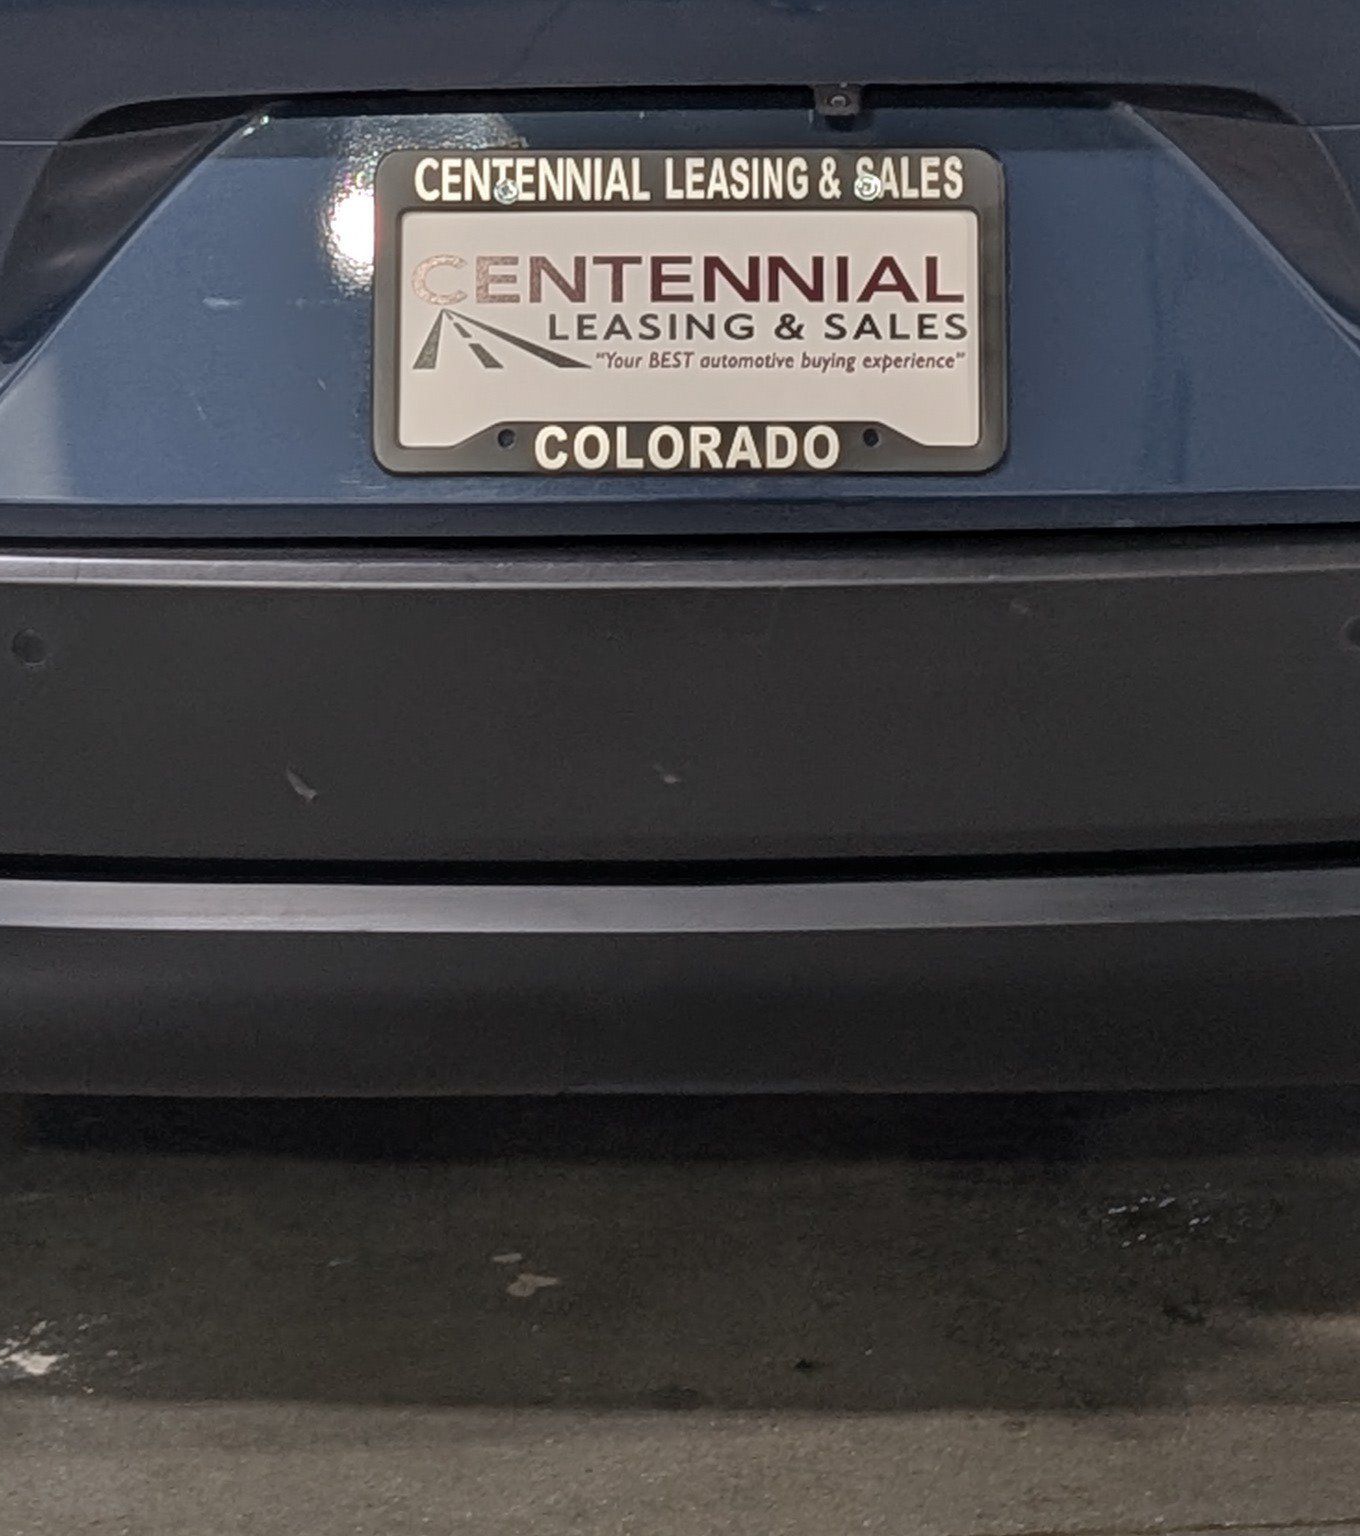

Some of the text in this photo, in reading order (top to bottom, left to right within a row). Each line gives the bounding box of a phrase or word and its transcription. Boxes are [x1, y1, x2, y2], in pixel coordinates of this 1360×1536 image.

[414, 157, 651, 202] CENTENNIAL
[664, 156, 809, 200] LEASING
[818, 156, 842, 200] &
[411, 253, 965, 306] CENTENNIAL
[548, 312, 968, 341] LEASING & SALES
[595, 351, 966, 373] "Your BEST automotive buying experience"
[534, 424, 841, 471] COLORADO
